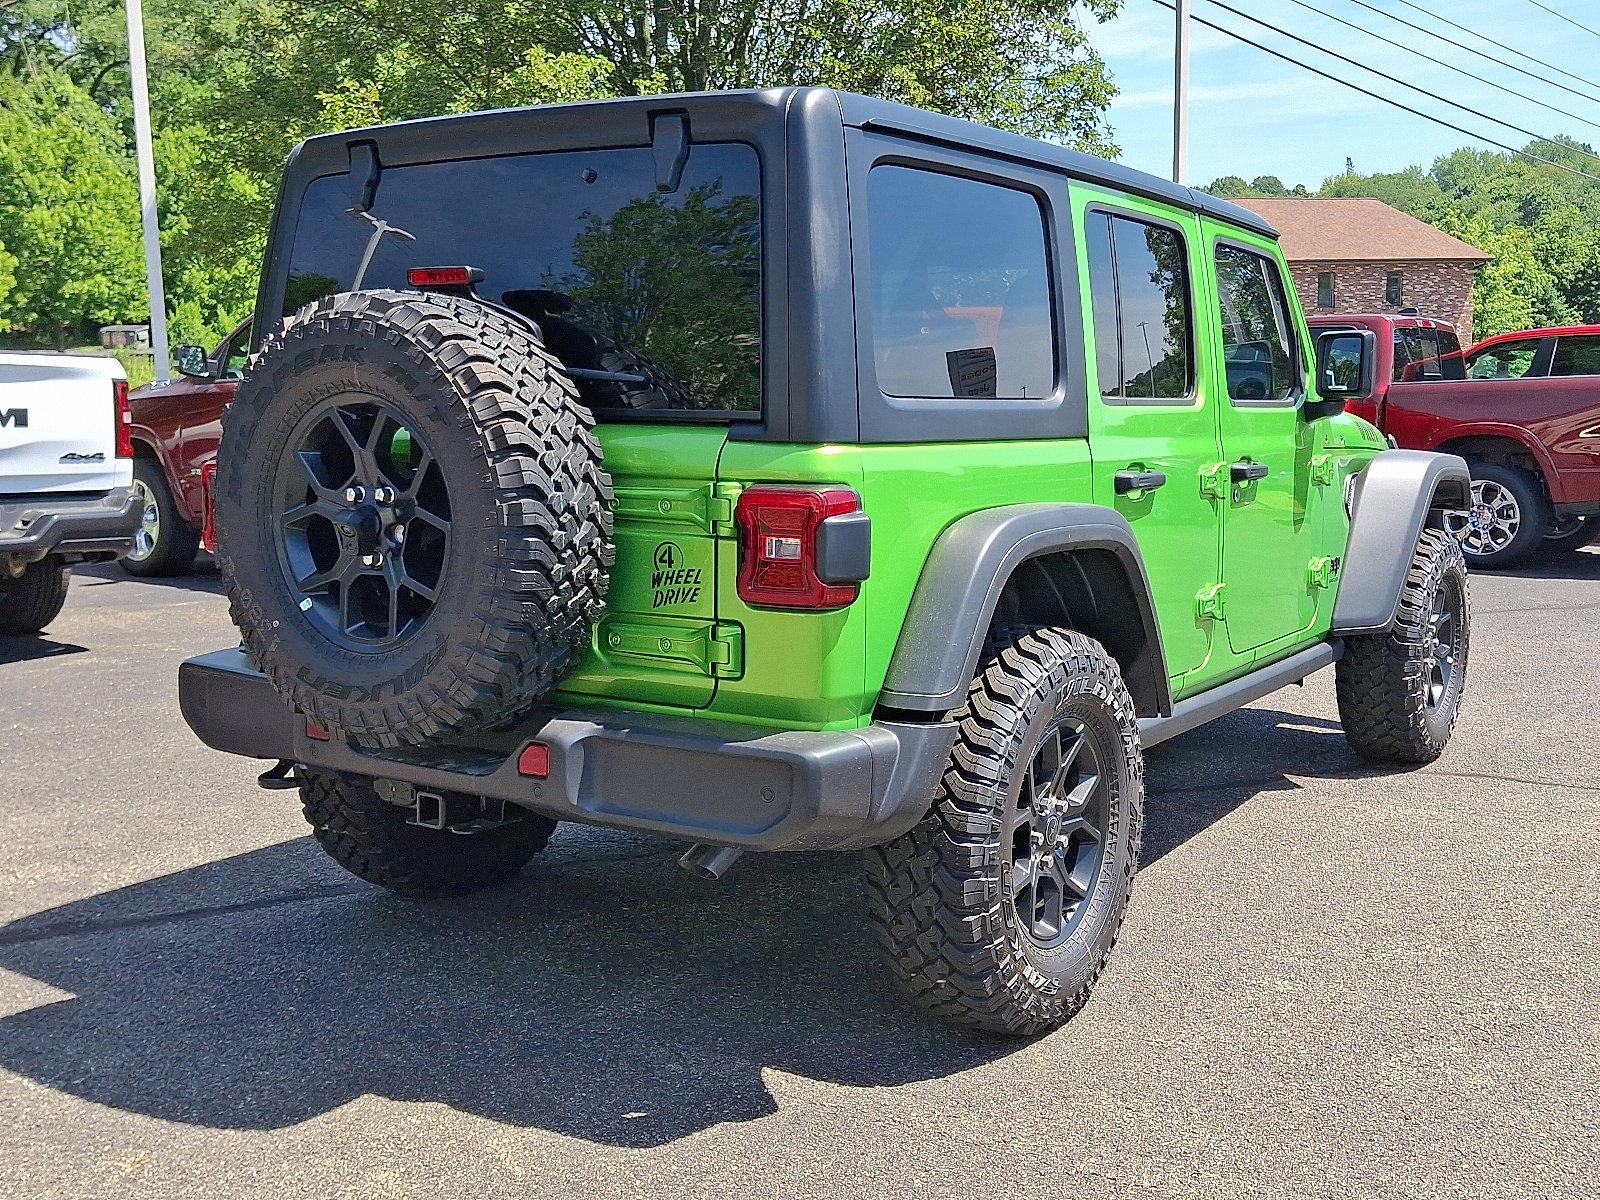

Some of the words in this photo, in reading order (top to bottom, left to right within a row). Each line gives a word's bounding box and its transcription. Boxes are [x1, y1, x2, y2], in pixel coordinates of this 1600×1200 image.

[659, 545, 674, 568] 4
[651, 568, 702, 589] WHEEL
[653, 587, 701, 608] DRIVE
[1056, 676, 1138, 780] WILDPEAK
